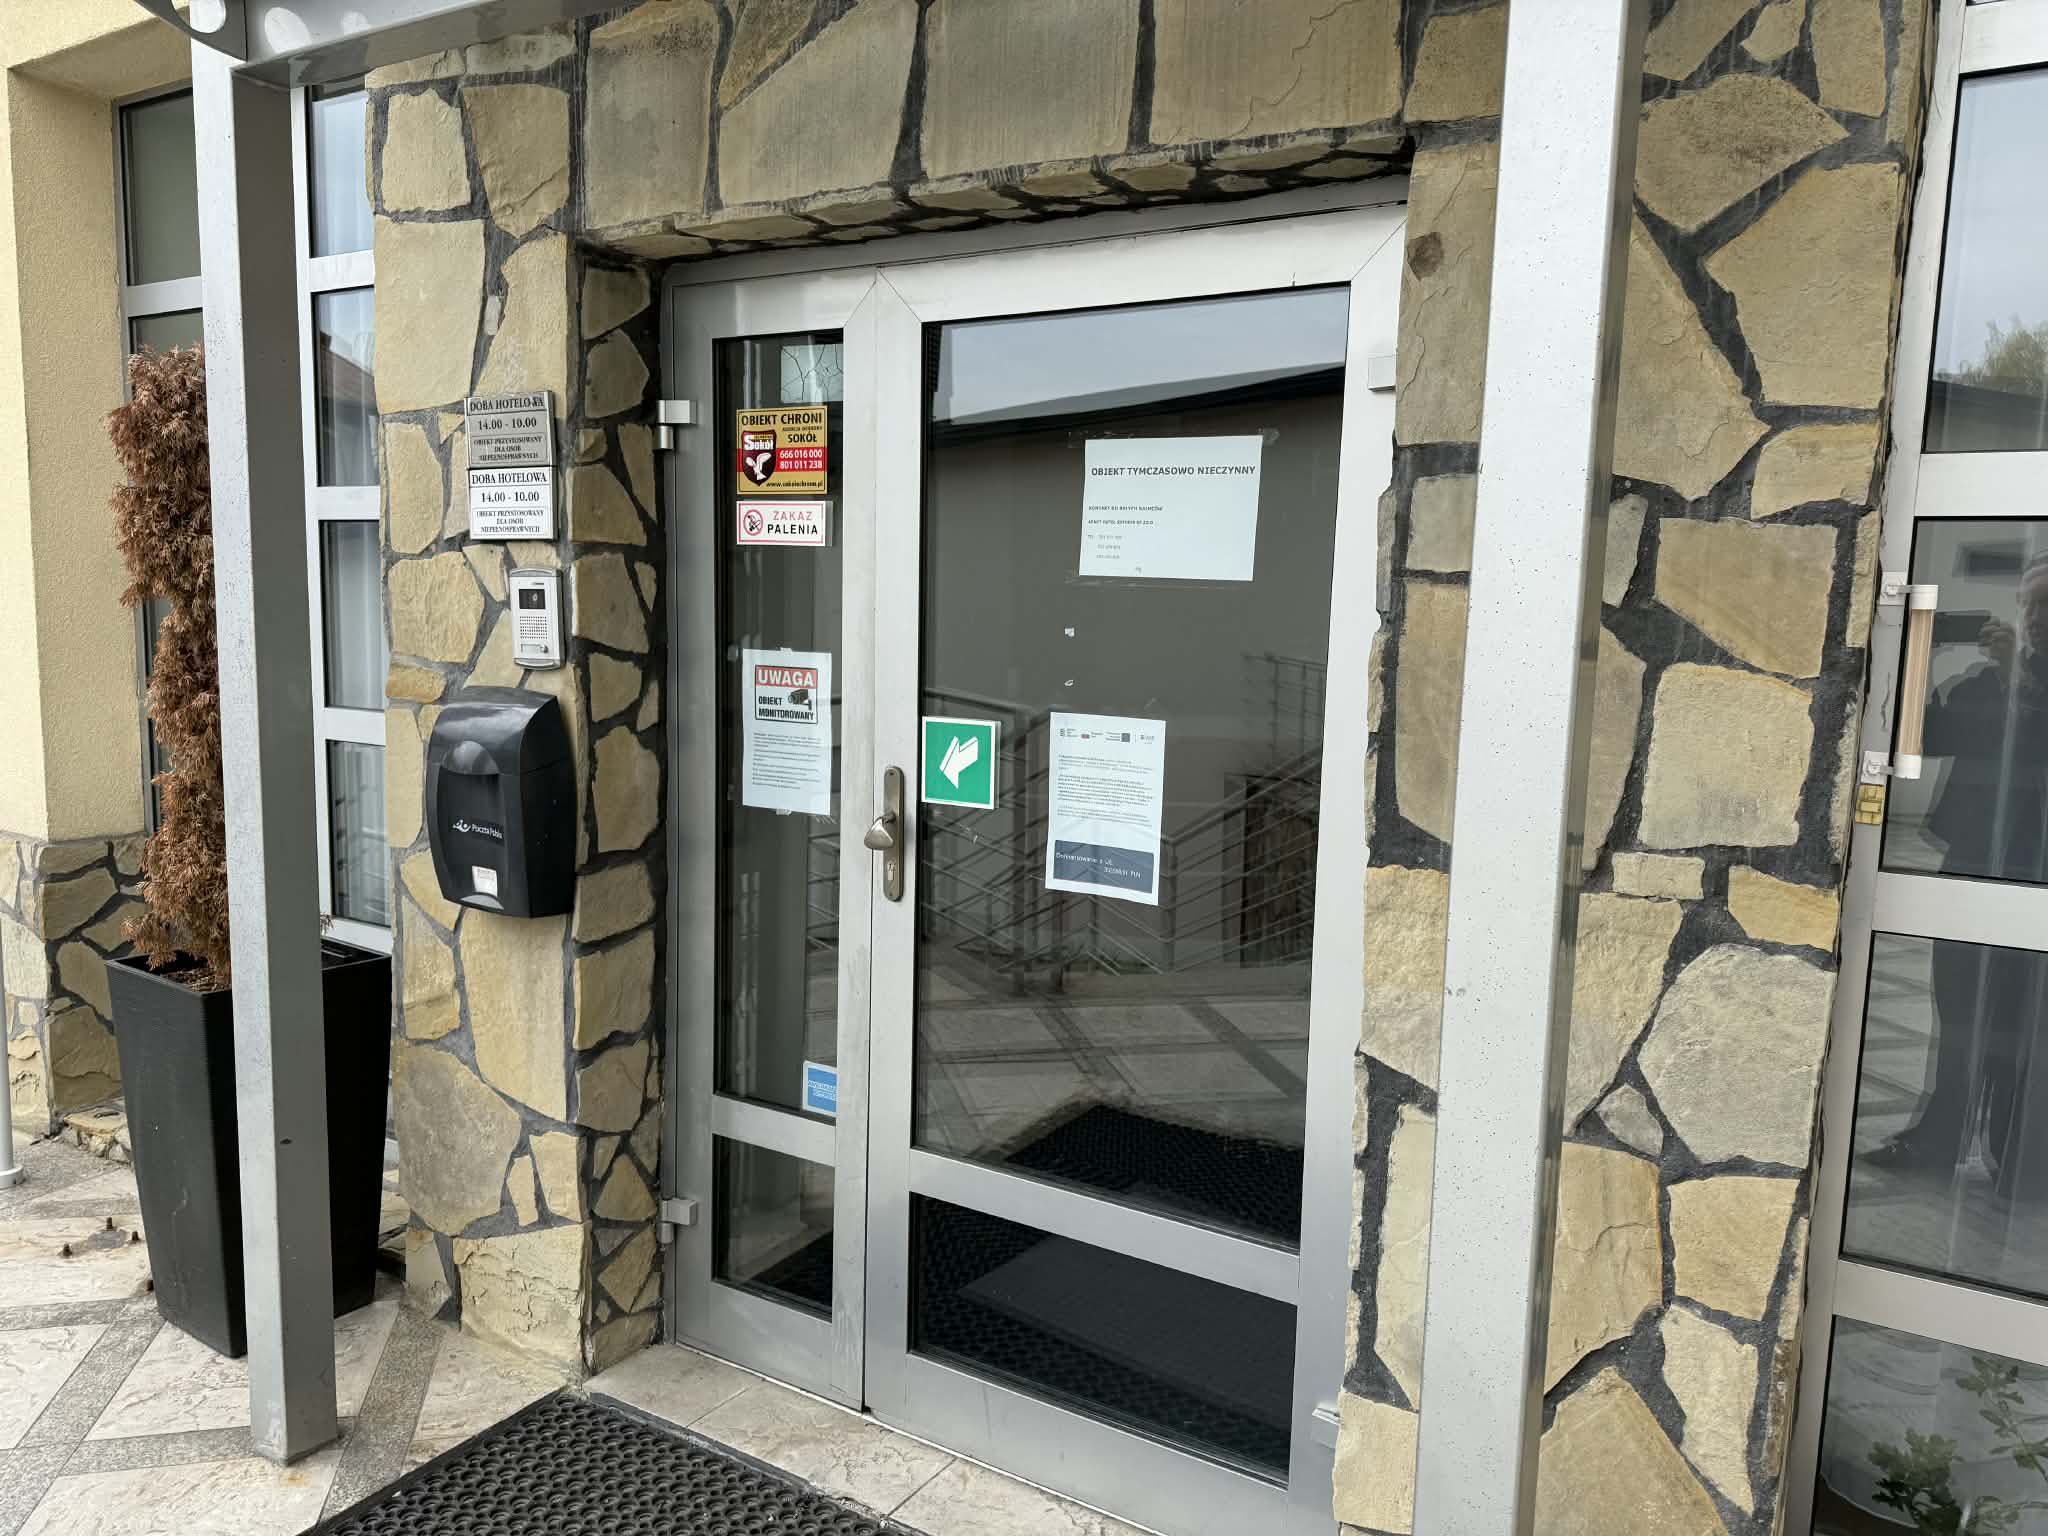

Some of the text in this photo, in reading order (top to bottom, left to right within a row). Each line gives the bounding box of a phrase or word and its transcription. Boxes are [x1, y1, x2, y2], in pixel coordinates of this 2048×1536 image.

[470, 397, 544, 412] DOBA HOTELOWA
[479, 419, 503, 430] 14.00
[512, 417, 537, 428] 10.00
[741, 412, 822, 426] OBIEKT CHRONI
[787, 431, 817, 443] SOKÓŁ
[809, 449, 823, 458] 000
[794, 460, 807, 469] 011
[1091, 465, 1256, 476] OBIEKT TYMCZASOWO NIECZYNNY
[472, 472, 547, 485] DOBA HOTELOWA
[481, 491, 506, 503] 14.00
[514, 491, 540, 502] 10.00
[773, 511, 812, 521] ZAKAZ
[767, 524, 818, 535] PALENIA
[758, 669, 814, 687] UWAGA
[758, 695, 782, 706] OBIEKT
[758, 707, 814, 721] MONITOROWANY
